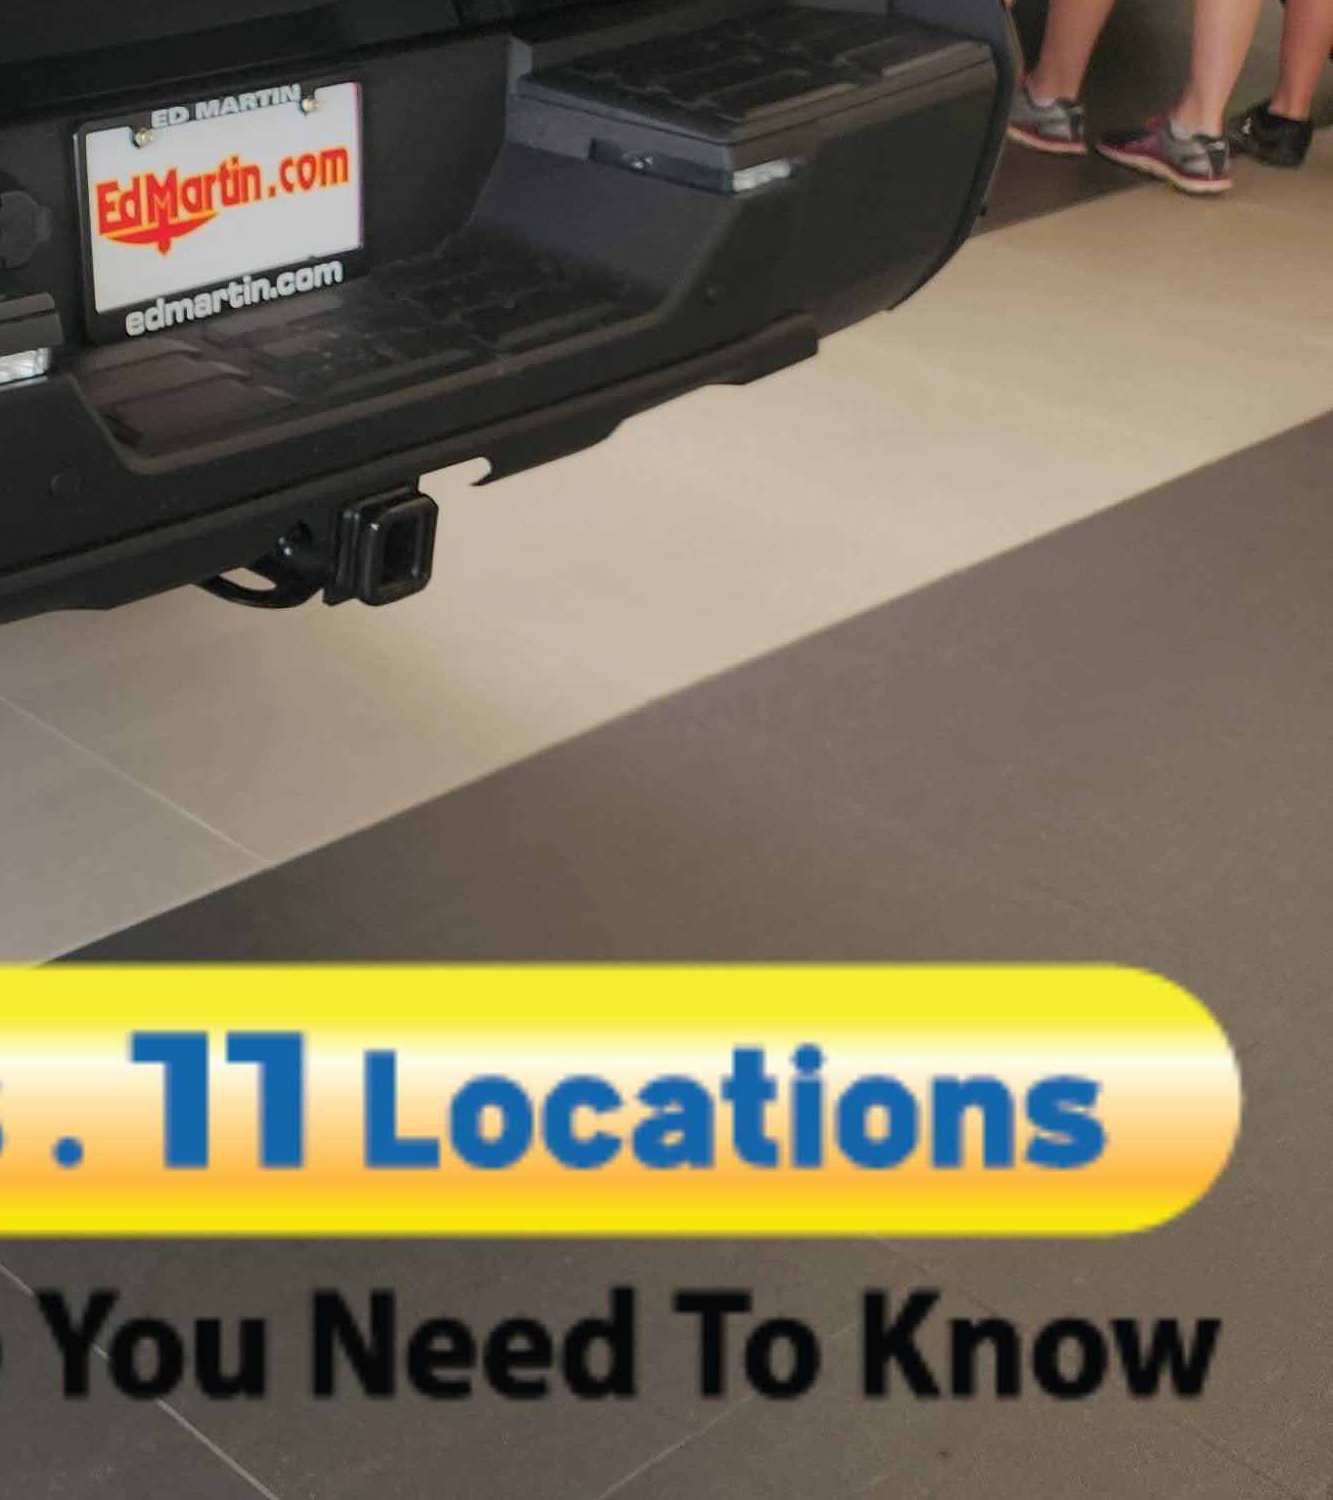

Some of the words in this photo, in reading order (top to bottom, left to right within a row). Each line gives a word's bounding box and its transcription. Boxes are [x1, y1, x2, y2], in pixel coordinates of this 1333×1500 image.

[151, 106, 190, 129] ED
[195, 83, 301, 120] MARTIN
[125, 260, 344, 337] edmartin.com
